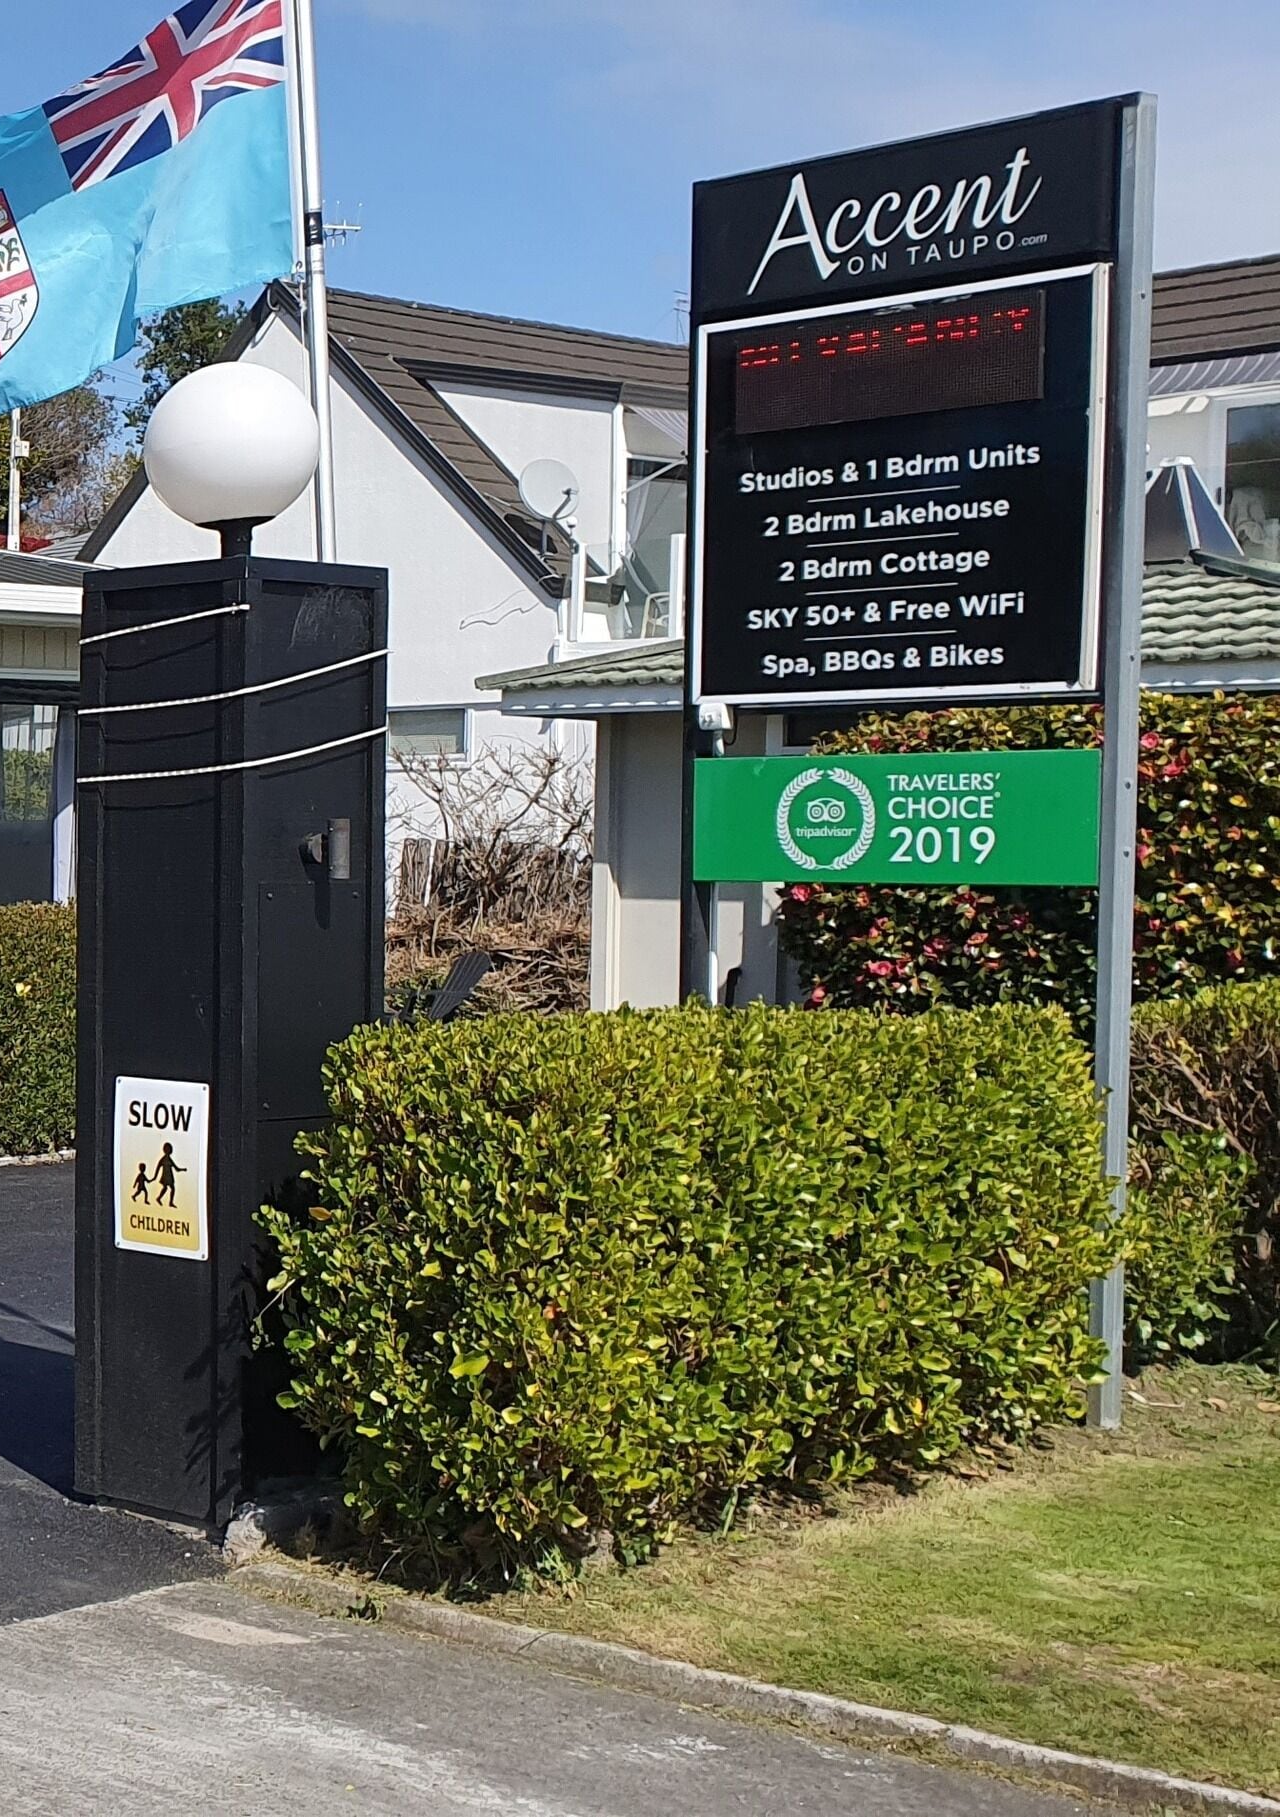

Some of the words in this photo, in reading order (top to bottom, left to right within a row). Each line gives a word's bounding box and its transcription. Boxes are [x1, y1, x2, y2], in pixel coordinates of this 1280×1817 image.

[747, 147, 1042, 295] Accent
[847, 251, 887, 275] ON
[741, 467, 833, 492] Studios
[842, 462, 858, 482] &
[867, 460, 876, 479] 1
[887, 454, 958, 478] Bdrm
[969, 444, 1040, 469] Units
[764, 517, 779, 536] 2
[788, 512, 855, 534] Bdrm
[864, 501, 1009, 528] Lakehouse
[779, 562, 794, 581] 2
[804, 557, 871, 579] Bdrm
[881, 551, 990, 574] Cottage
[748, 607, 798, 629] SKY
[806, 605, 855, 626] 50+
[864, 602, 880, 622] &
[891, 600, 950, 621] Free
[960, 592, 1024, 616] WiFi
[763, 655, 815, 677] Spa,
[825, 650, 894, 671] BBQs
[903, 648, 920, 668] &
[931, 644, 1003, 666] Bikes
[890, 826, 995, 864] 2019
[129, 1101, 192, 1131] SLOW
[130, 1215, 189, 1236] CHILDREN
